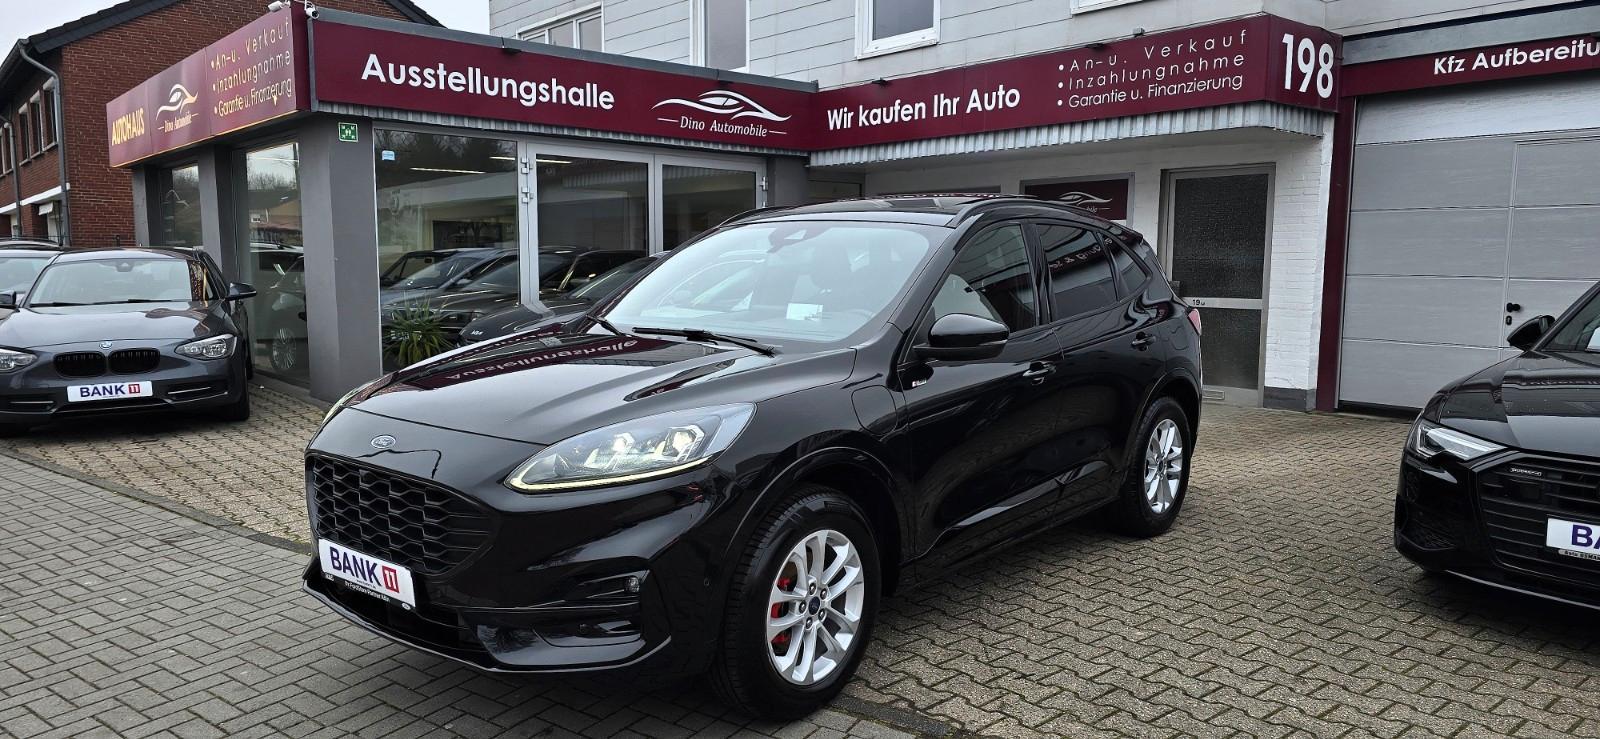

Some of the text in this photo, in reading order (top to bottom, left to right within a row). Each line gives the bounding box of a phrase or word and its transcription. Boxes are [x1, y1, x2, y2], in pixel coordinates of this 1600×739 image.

[245, 16, 289, 56] Verkauf
[1144, 29, 1247, 60] Verkauf
[217, 50, 291, 94] Inzahlungnahme
[1069, 54, 1245, 90] Inzahlungnahme
[1281, 33, 1335, 98] 198
[1434, 38, 1600, 75] Kfz Aufbereitu
[250, 78, 292, 106] Finanzierung
[361, 54, 615, 111] Ausstellungshalle
[1068, 74, 1244, 108] Garantie u. Finanzierung
[111, 107, 145, 146] AUTOHAUS
[680, 115, 768, 137] Dino Automobile
[827, 84, 1022, 131] Wir kaufen Ihr Auto
[80, 385, 126, 398] BANK
[329, 546, 382, 587] BANK
